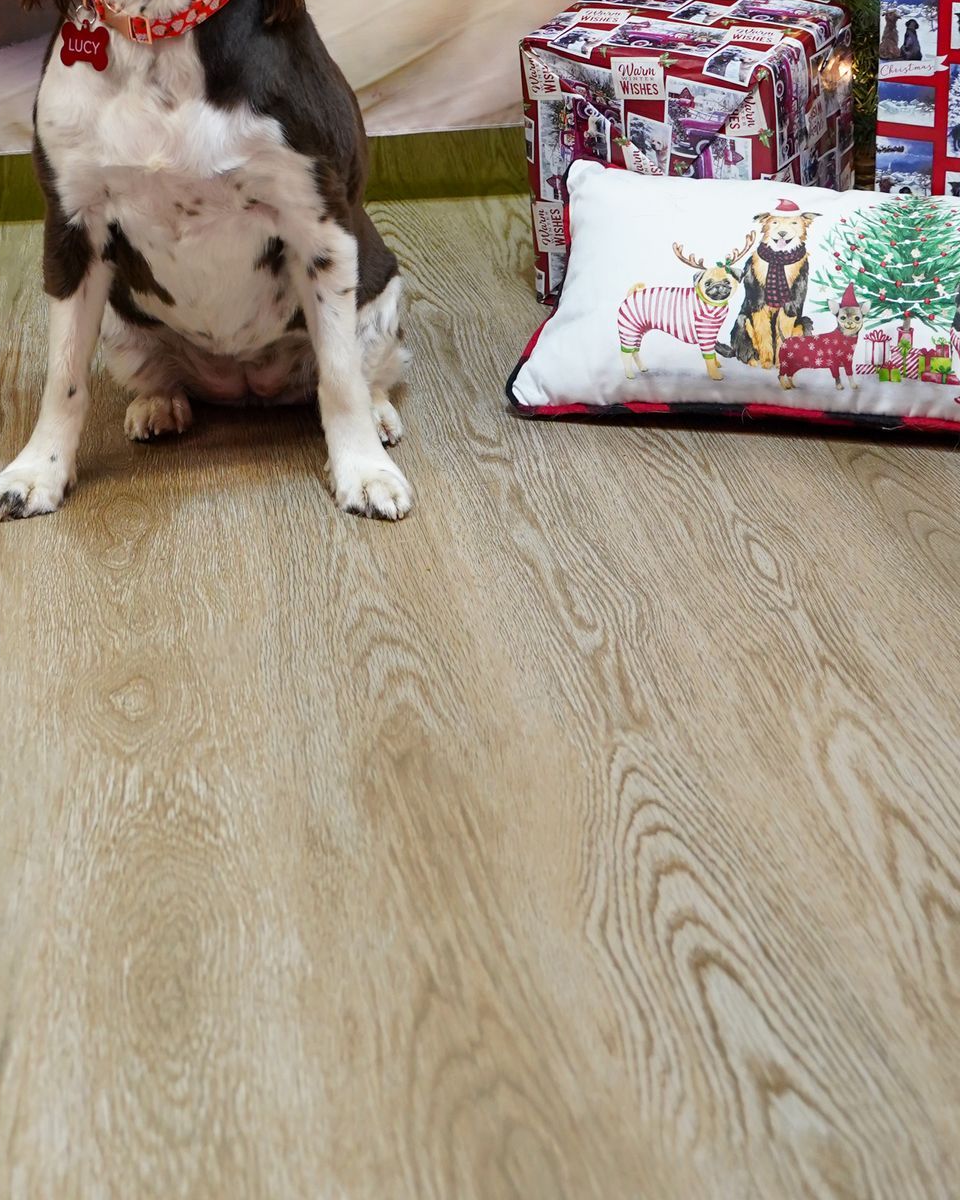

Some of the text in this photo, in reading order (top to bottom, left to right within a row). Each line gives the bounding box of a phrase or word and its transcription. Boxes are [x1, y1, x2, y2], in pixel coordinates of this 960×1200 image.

[68, 38, 100, 55] LUCY
[618, 63, 655, 77] Warm
[620, 81, 659, 96] WISHES
[550, 208, 567, 247] WISHES
